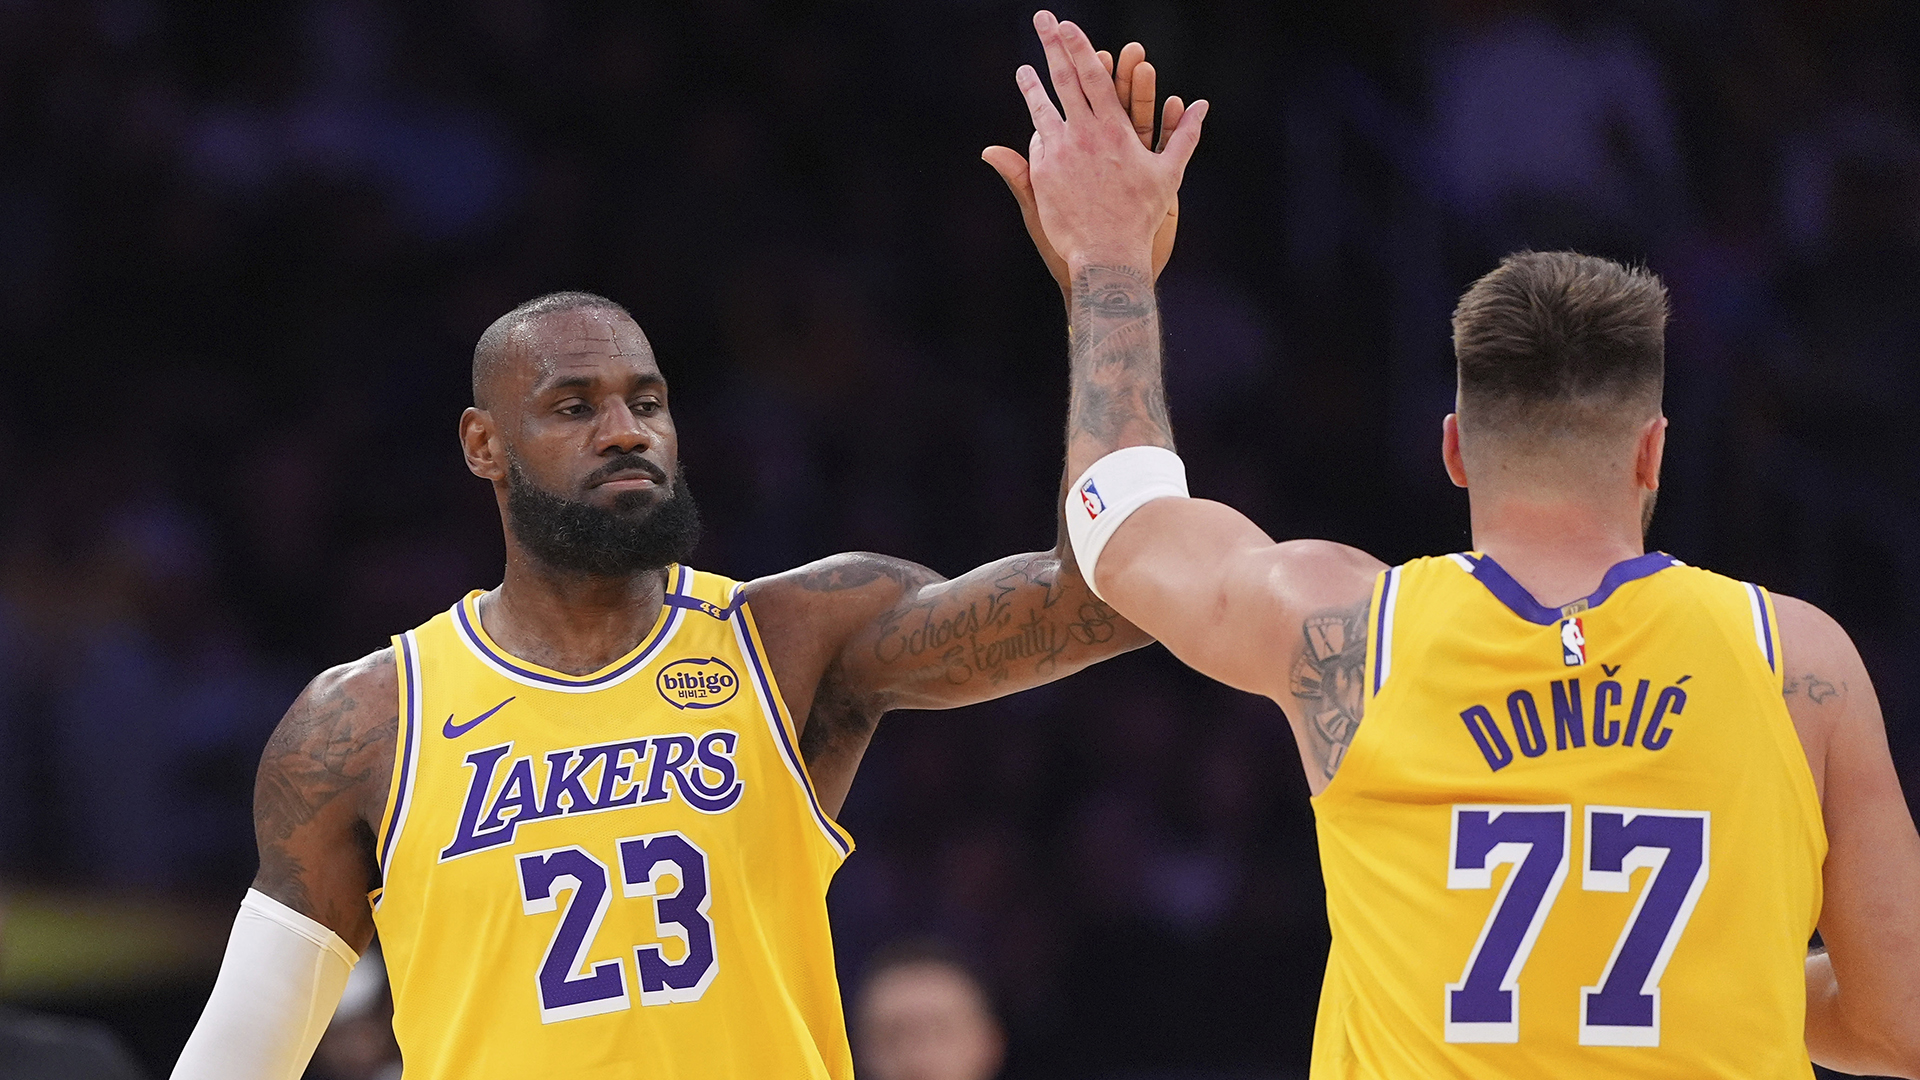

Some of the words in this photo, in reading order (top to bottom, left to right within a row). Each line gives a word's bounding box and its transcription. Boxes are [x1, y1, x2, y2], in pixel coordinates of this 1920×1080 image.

[700, 603, 721, 618] 44
[875, 602, 979, 665] Echoes
[941, 608, 1068, 685] Eternity
[663, 671, 733, 694] bibigo
[678, 690, 708, 699] 비비고
[1459, 664, 1693, 772] DONČIĆ
[437, 729, 745, 864] LAKERS
[514, 830, 720, 1025] 23
[1445, 804, 1711, 1048] 77
